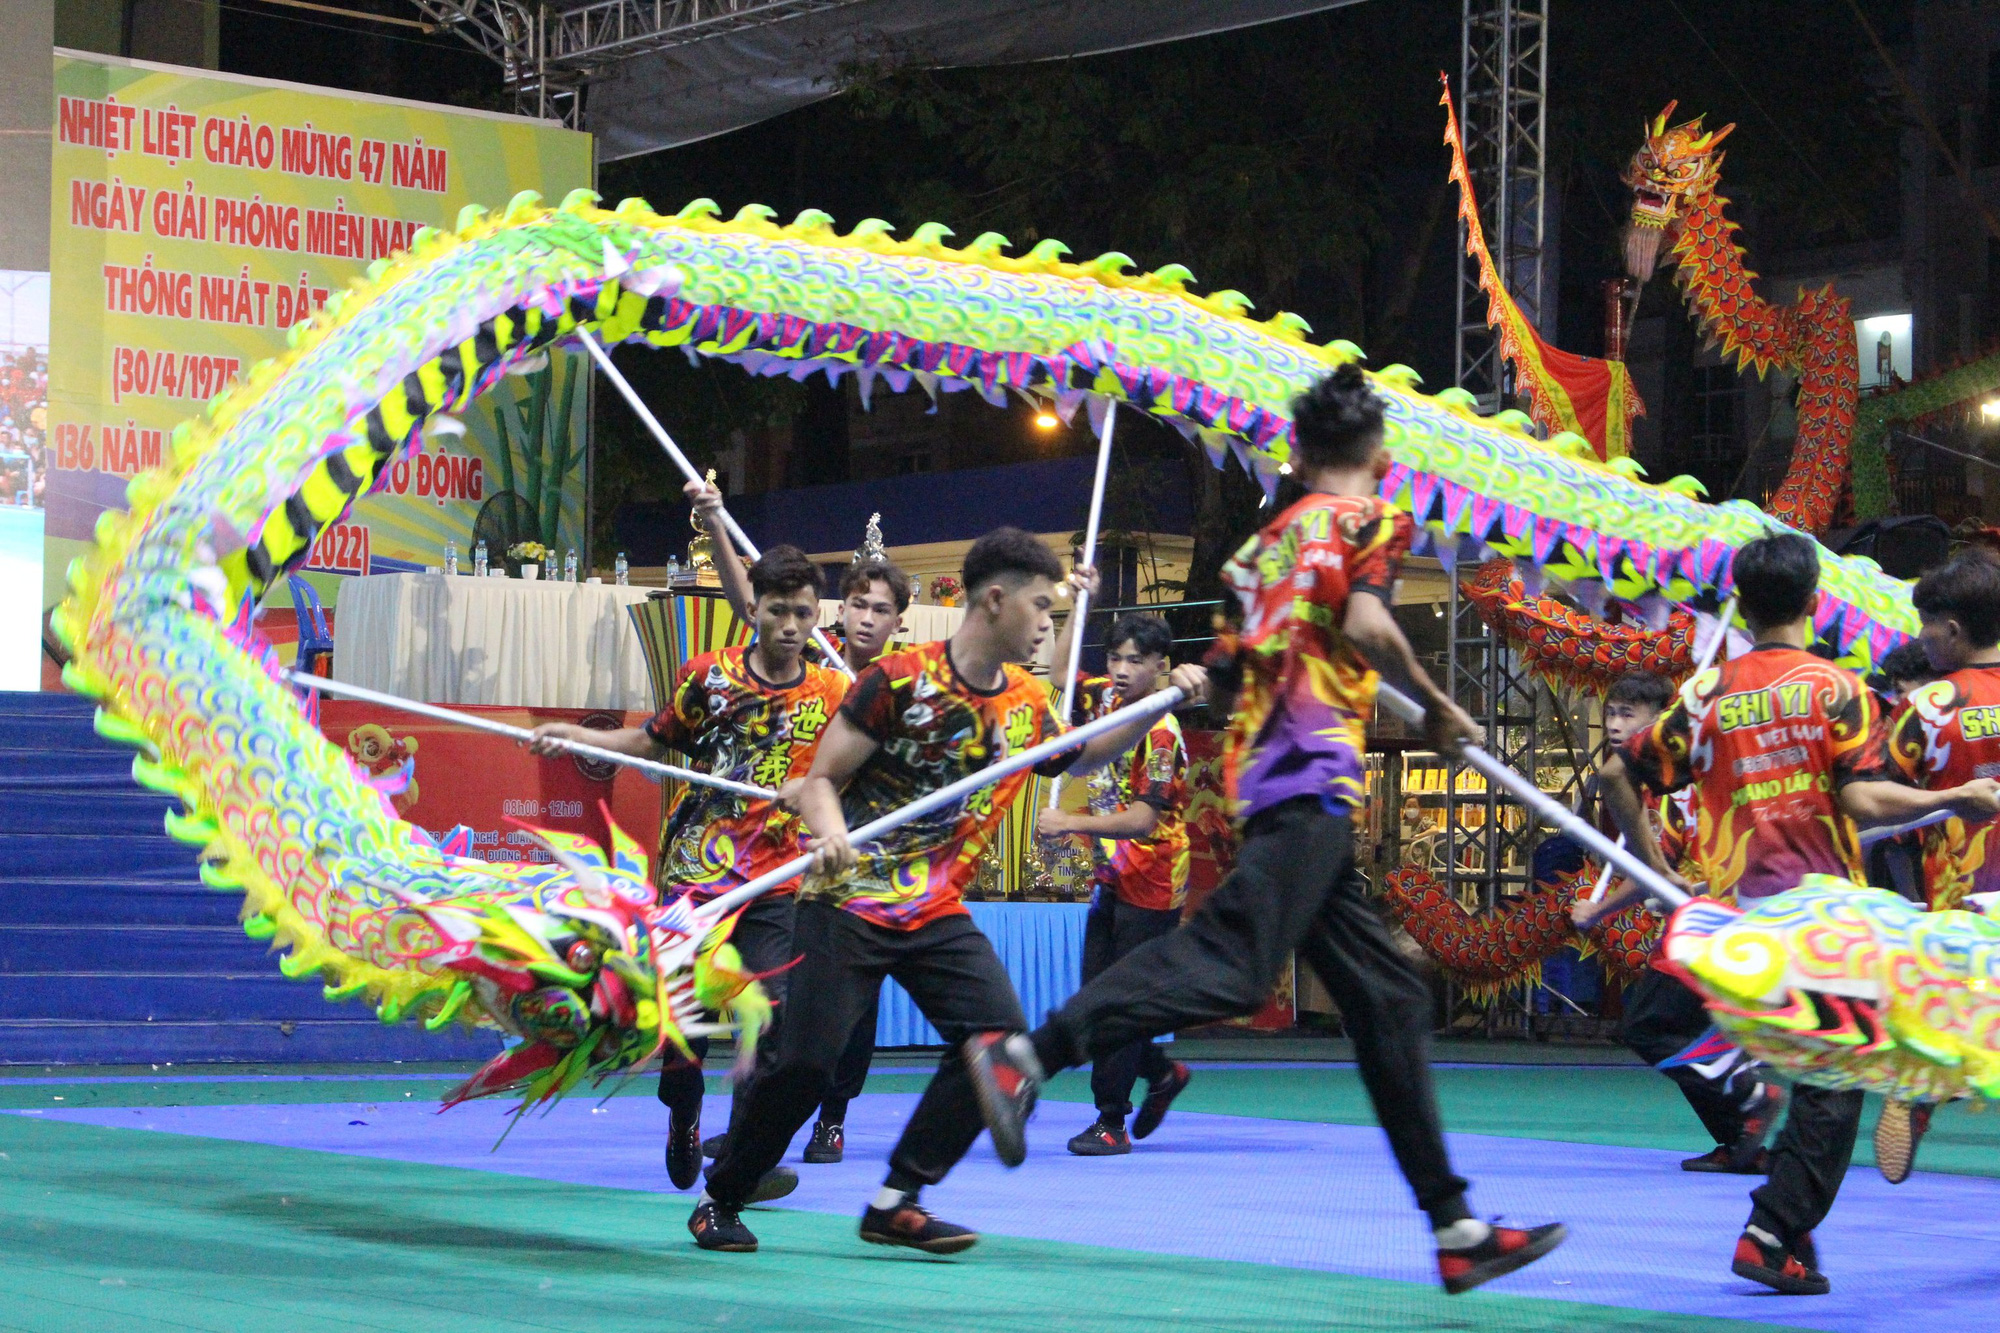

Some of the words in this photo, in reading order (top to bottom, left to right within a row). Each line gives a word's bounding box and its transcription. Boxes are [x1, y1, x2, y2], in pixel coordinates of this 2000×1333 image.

[59, 96, 136, 158] NHIỆT
[143, 105, 197, 166] LIỆT
[203, 115, 274, 169] CHÀO
[281, 122, 352, 180] MỪNG
[358, 139, 386, 183] 47
[392, 138, 447, 192] NĂM
[71, 177, 146, 232] NGÀY
[153, 180, 207, 240] GIẢI
[214, 195, 299, 251] PHÓNG
[305, 197, 365, 259] MIỀN
[103, 254, 192, 319] THỐNG
[199, 265, 270, 326] NHẤT
[276, 272, 329, 329] ĐẤT
[55, 423, 94, 470] 136
[102, 420, 162, 473] NĂM
[416, 447, 482, 505] ĐỘNG
[1718, 688, 1773, 732] SHI
[1778, 683, 1812, 718] YI
[503, 799, 539, 816] 08h00
[548, 800, 583, 817] 12h00
